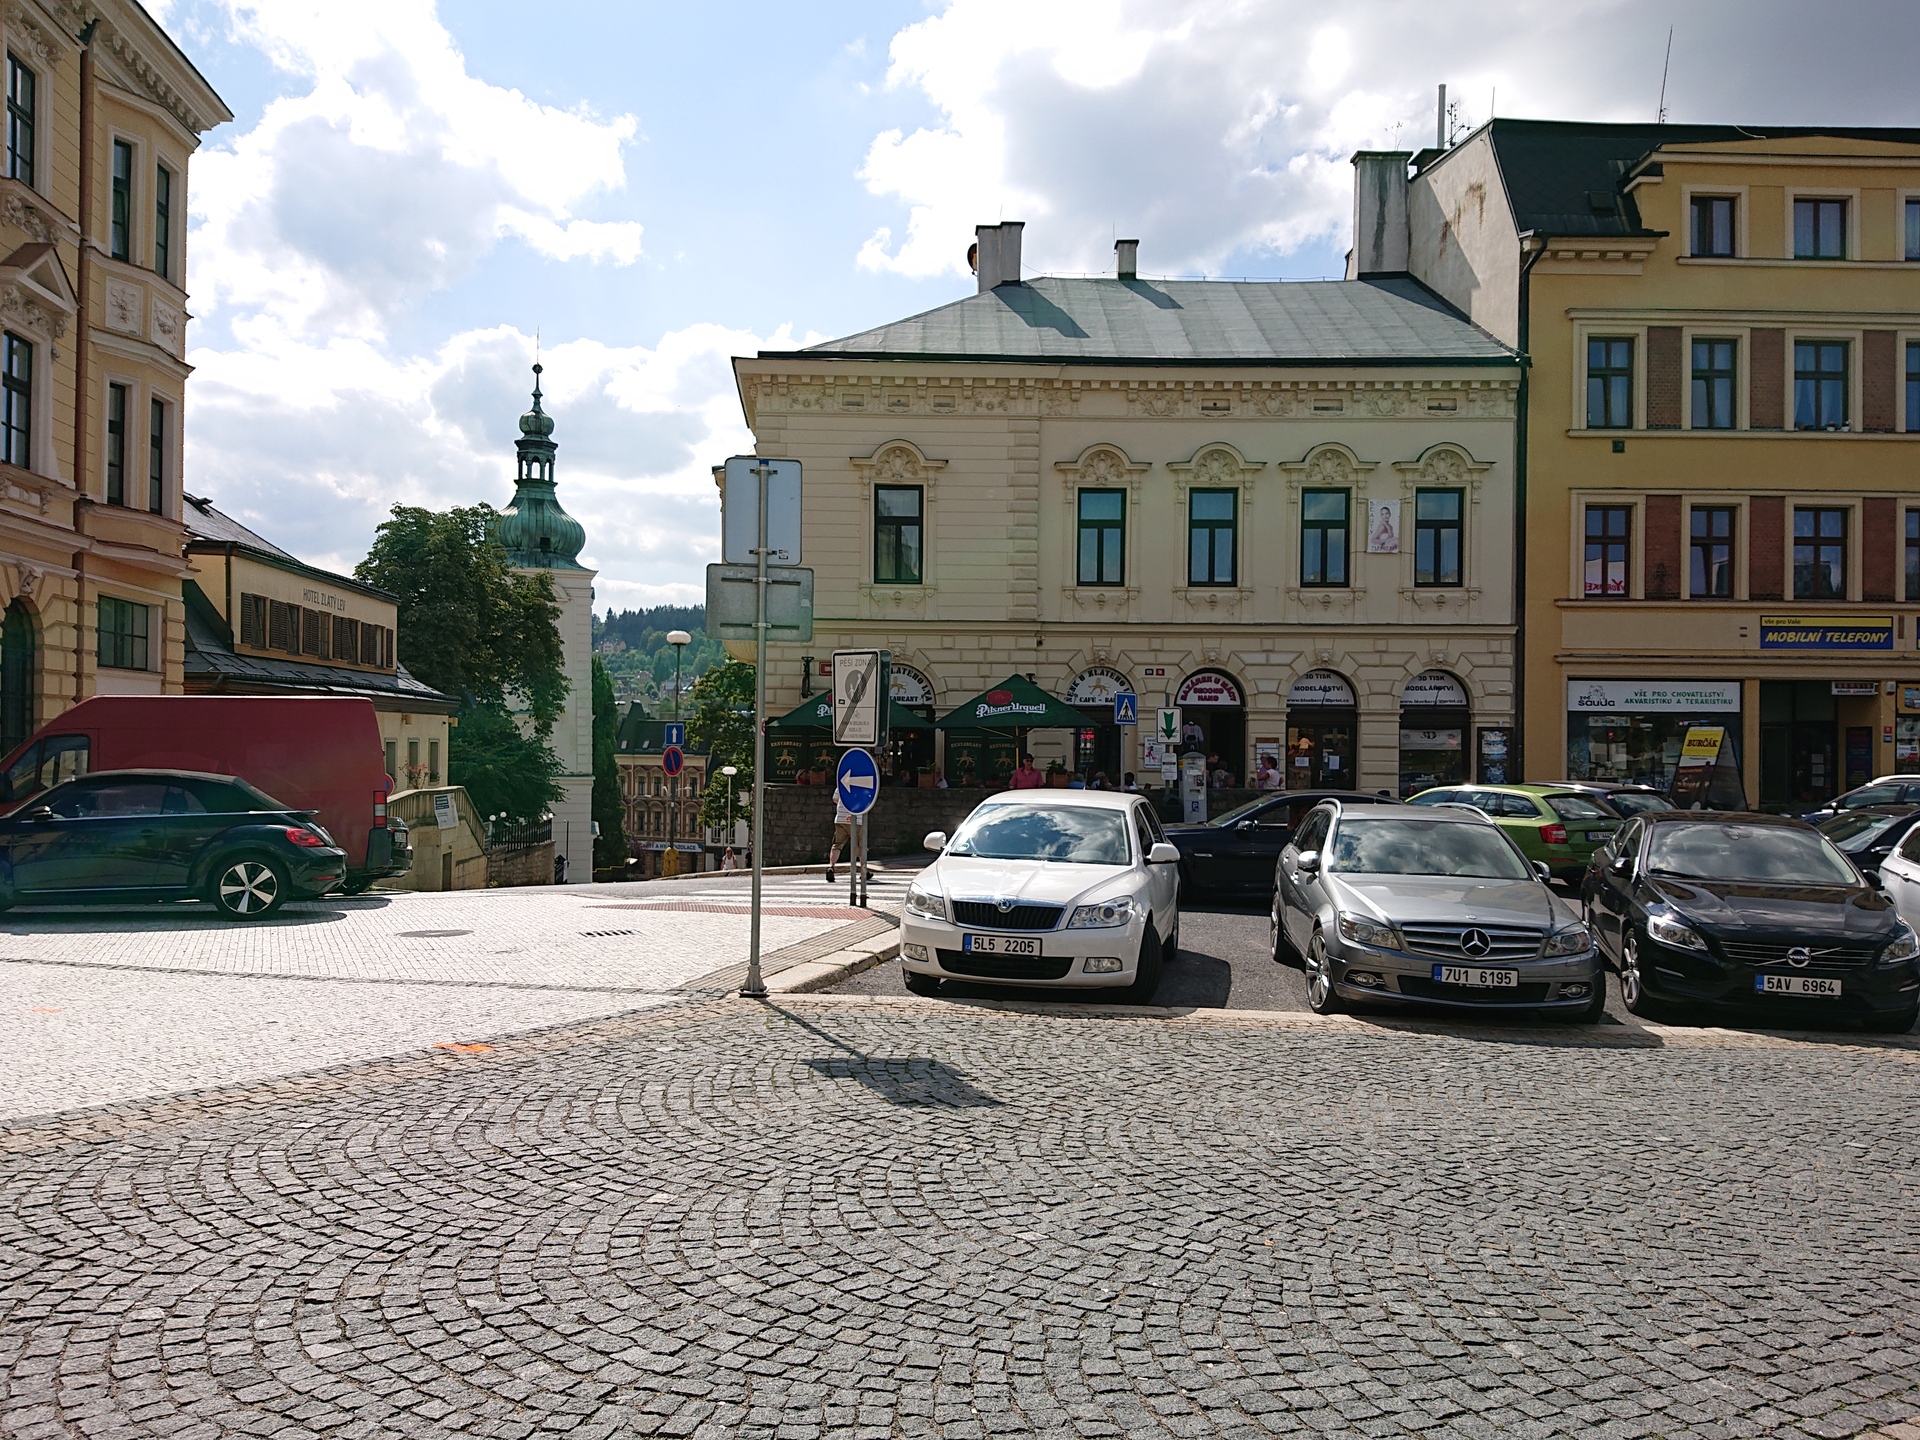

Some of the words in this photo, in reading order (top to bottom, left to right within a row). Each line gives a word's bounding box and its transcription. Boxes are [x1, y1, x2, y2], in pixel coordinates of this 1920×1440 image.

[302, 588, 320, 605] HOTEL
[321, 593, 337, 610] ZLATÝ
[337, 598, 346, 612] LEV
[1775, 618, 1787, 626] pro
[1765, 629, 1824, 643] MOBILNÍ
[1825, 631, 1889, 644] TELEFONY
[1078, 674, 1086, 682] U
[1213, 677, 1222, 685] U
[1193, 687, 1225, 695] SECOND
[1633, 689, 1647, 697] VŠE
[1671, 689, 1726, 698] CHOVATELSTVÍ
[976, 703, 1011, 718] Pilsner
[1011, 702, 1047, 714] Urquell
[1421, 731, 1437, 740] 3D
[1686, 738, 1719, 748] BURČÁK
[974, 937, 996, 951] 5L5
[1004, 940, 1035, 954] 2205
[1445, 968, 1469, 983] 7U1
[1480, 971, 1512, 985] 6195
[1767, 977, 1792, 991] 5AV
[1802, 980, 1836, 994] 6964
